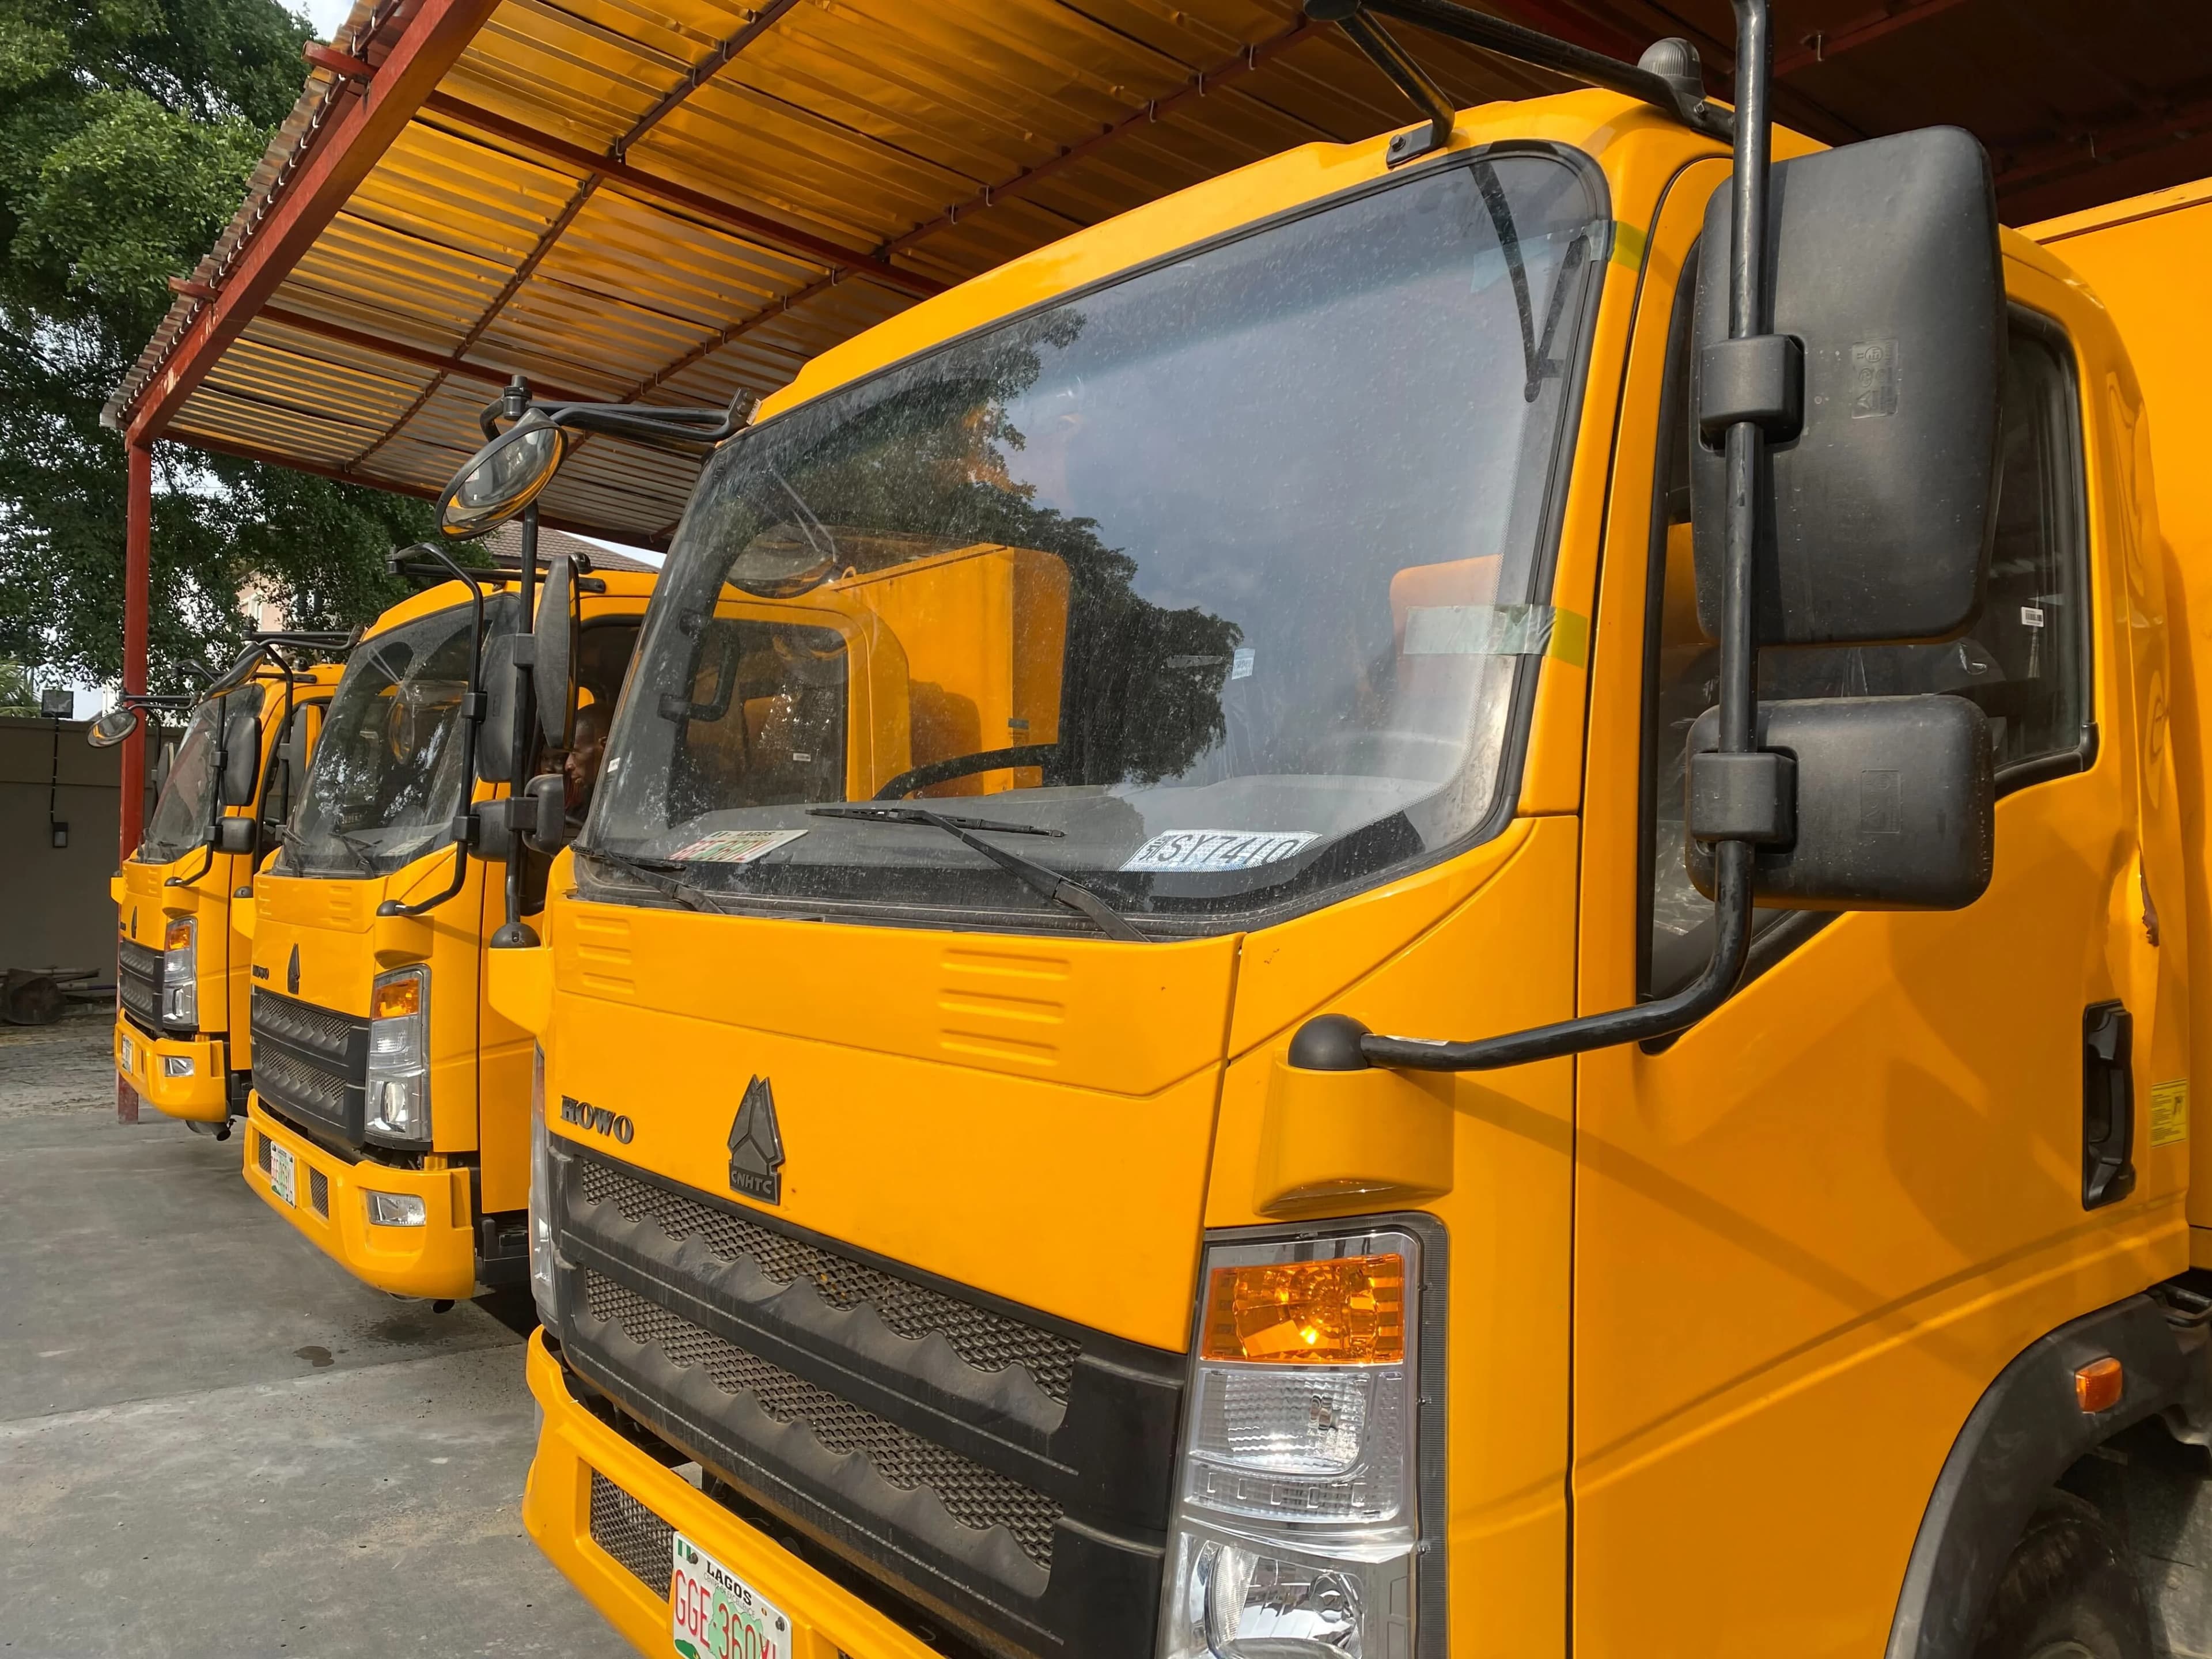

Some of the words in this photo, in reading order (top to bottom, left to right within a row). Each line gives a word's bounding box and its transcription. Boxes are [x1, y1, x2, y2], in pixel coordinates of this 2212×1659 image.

[560, 1094, 634, 1145] HOWO
[731, 1170, 772, 1195] CNHTC
[706, 1560, 752, 1606] LAGOS
[727, 1590, 756, 1619] EXCELLENCE
